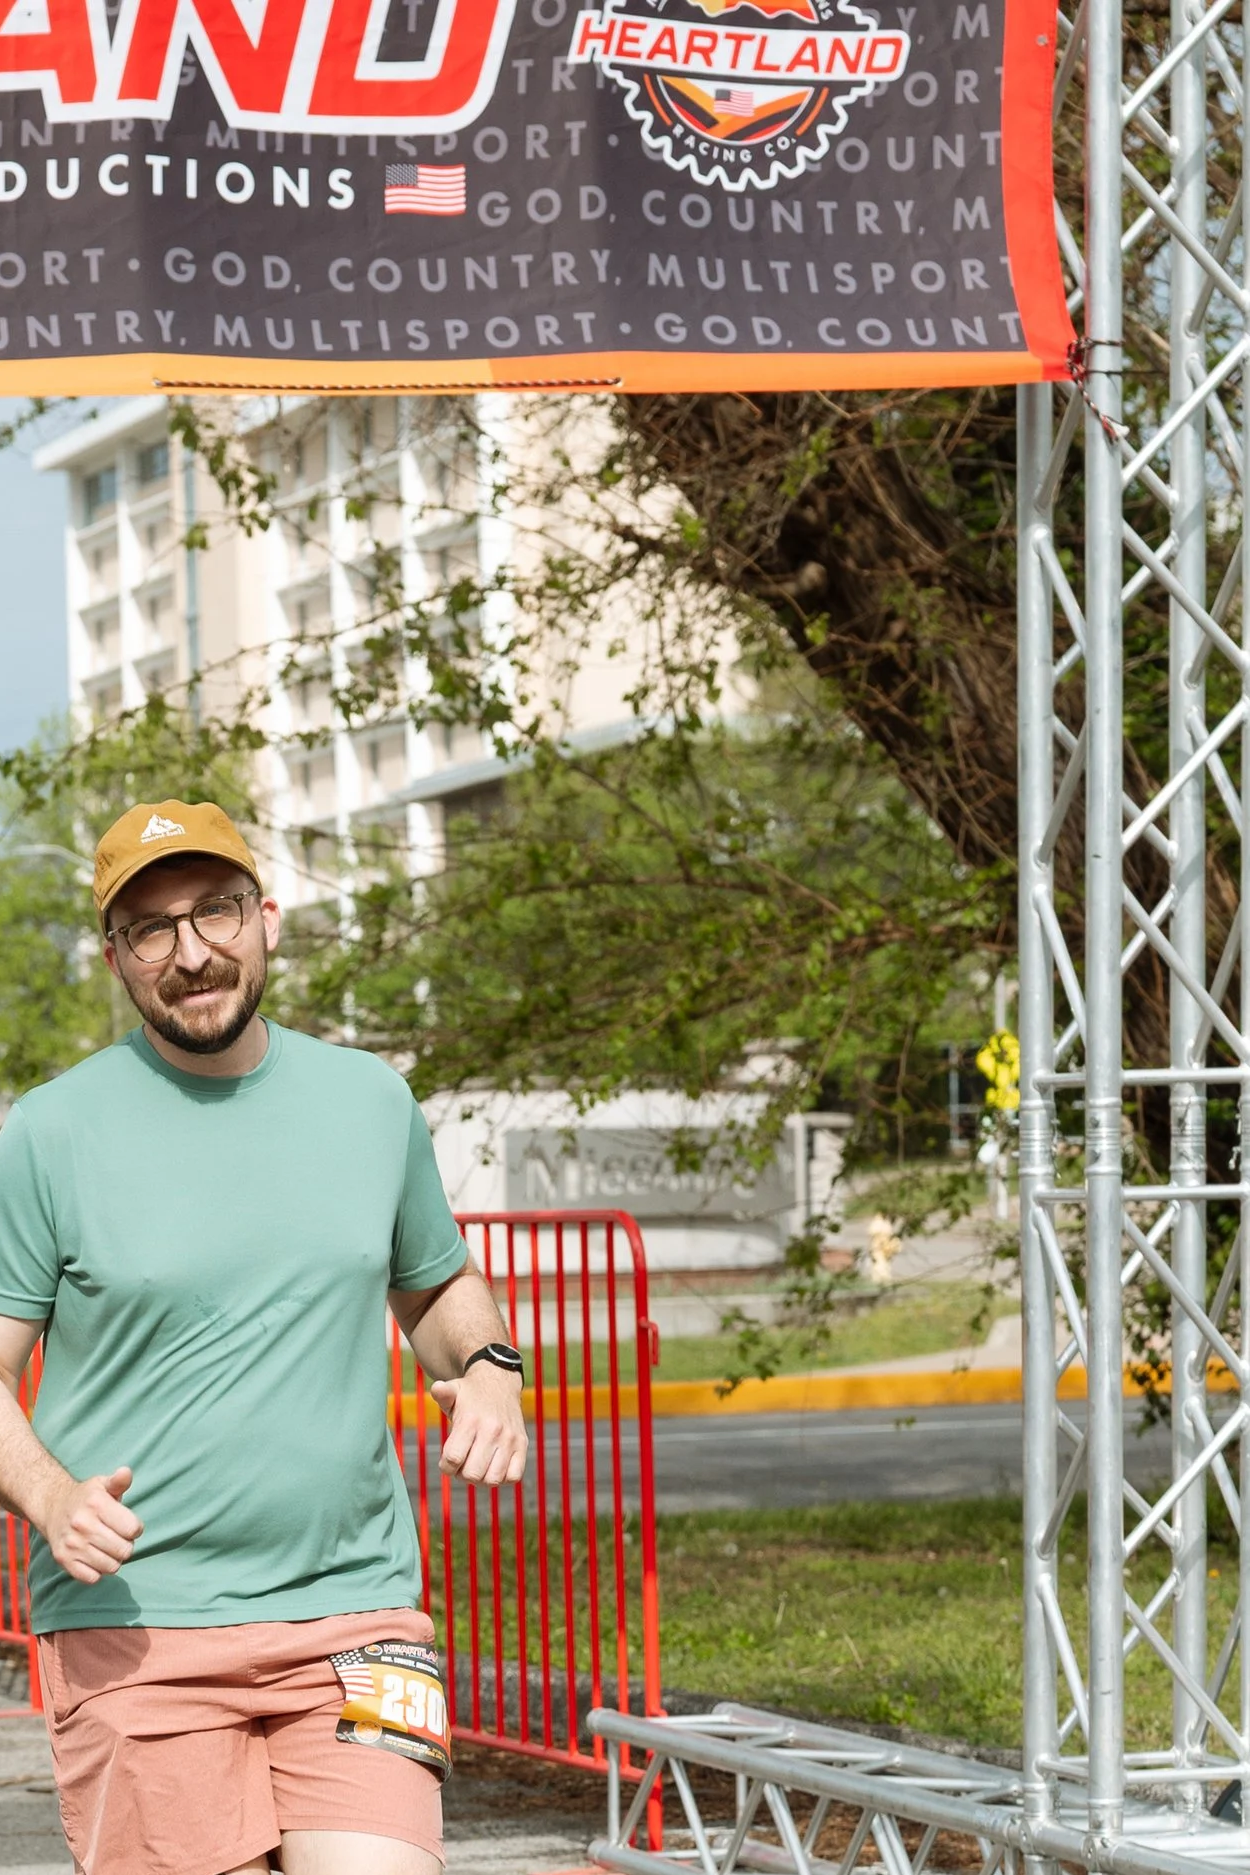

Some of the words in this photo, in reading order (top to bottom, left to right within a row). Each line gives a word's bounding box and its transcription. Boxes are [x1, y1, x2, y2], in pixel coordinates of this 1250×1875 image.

[576, 17, 903, 74] HEARTLAND
[671, 123, 753, 163] RACING
[478, 191, 618, 228] GOD,
[642, 193, 925, 236] COUNTRY,
[164, 247, 301, 294] GOD,
[328, 251, 622, 295] COUNTRY,
[215, 312, 615, 352] MULTISPORT
[654, 313, 793, 348] GOD,
[818, 311, 1026, 347] COUNT
[380, 1674, 447, 1741] 230
